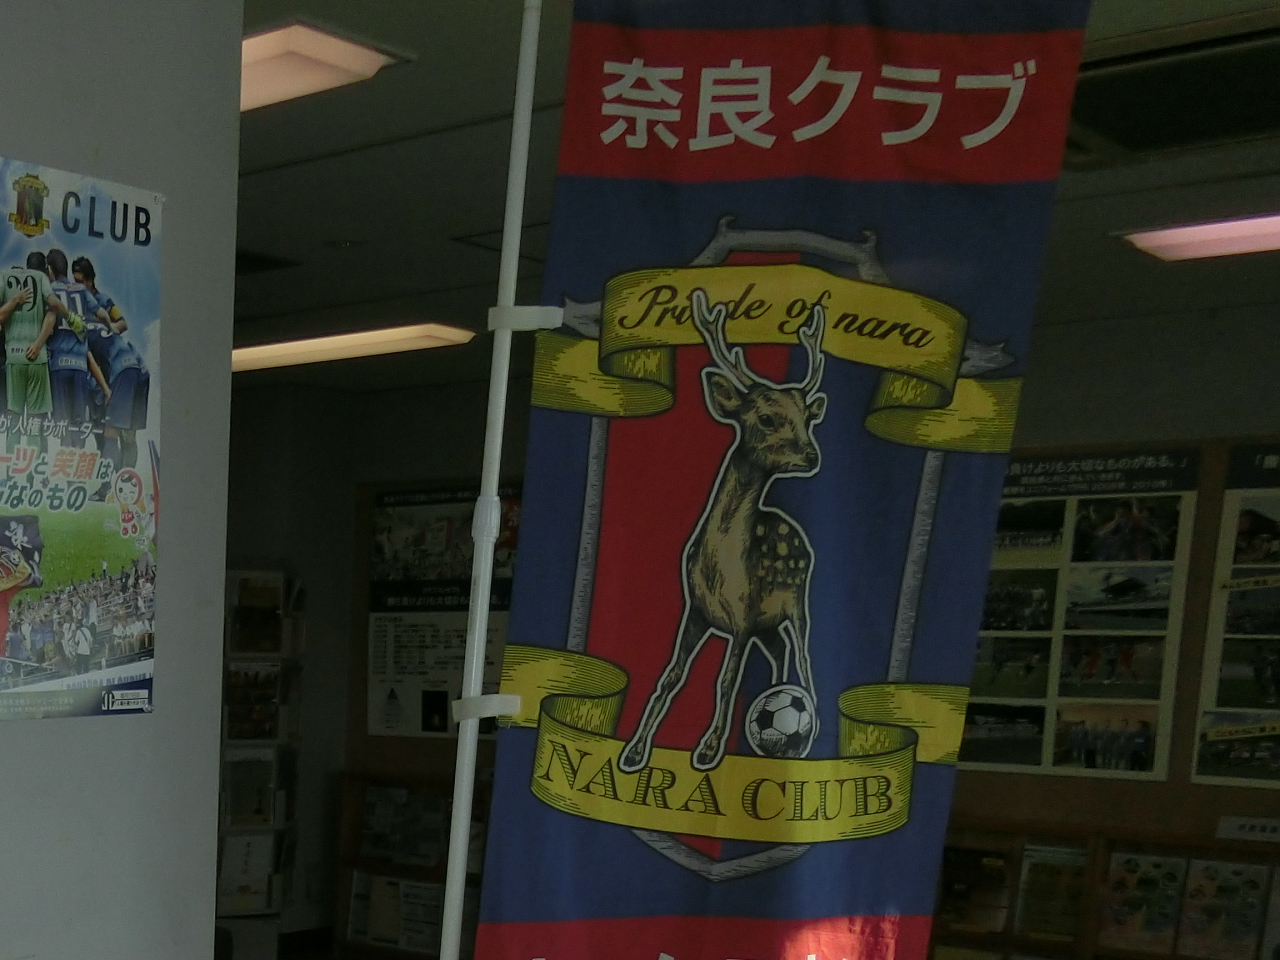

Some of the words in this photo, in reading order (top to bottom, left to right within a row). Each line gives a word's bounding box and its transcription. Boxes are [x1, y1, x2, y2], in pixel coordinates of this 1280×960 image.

[600, 54, 1038, 152] 奈良クラブ
[61, 191, 152, 246] CLUB
[833, 313, 937, 350] nara
[541, 739, 726, 817] NARA
[741, 774, 893, 823] CLUB
